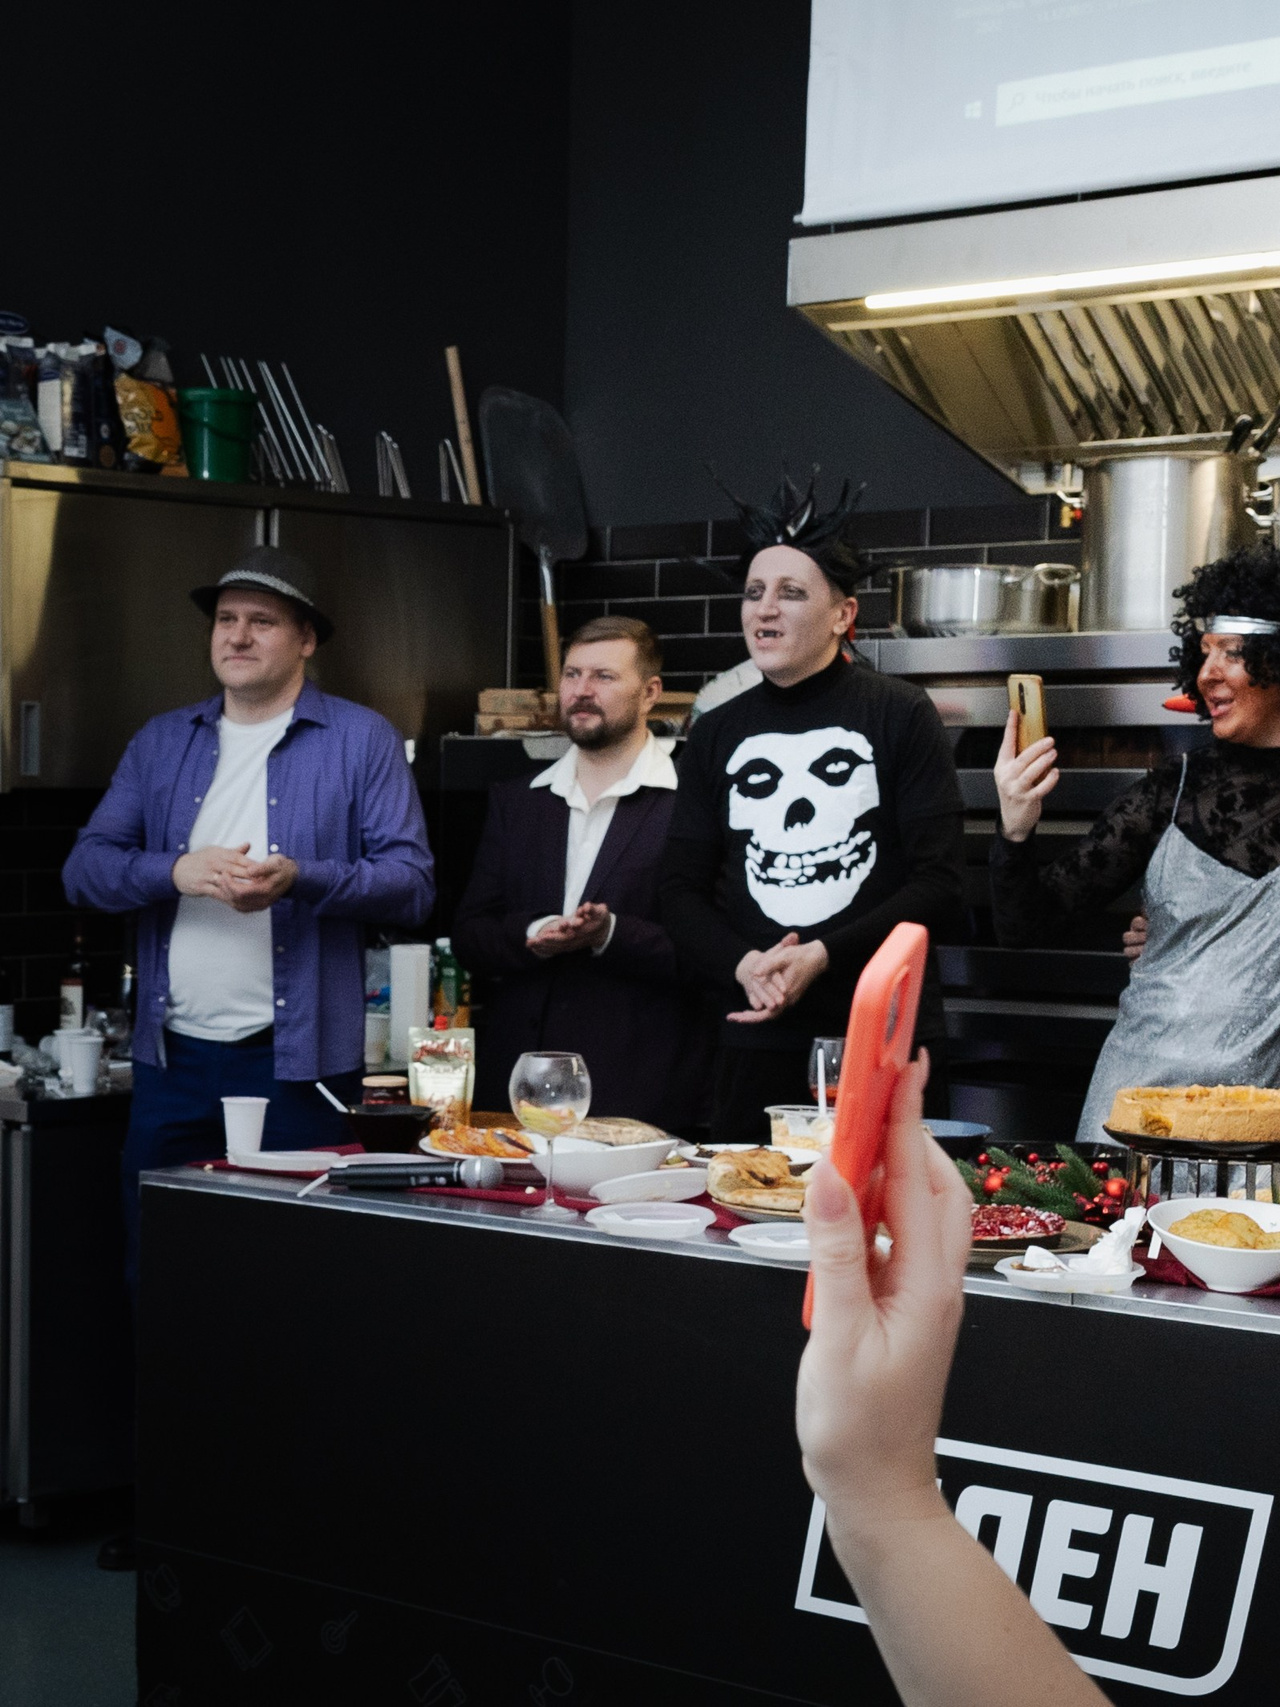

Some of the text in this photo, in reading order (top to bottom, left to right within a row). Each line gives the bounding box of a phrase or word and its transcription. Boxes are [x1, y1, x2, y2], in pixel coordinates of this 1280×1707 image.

[1035, 60, 1253, 106] Чтобы начать поиск, введите
